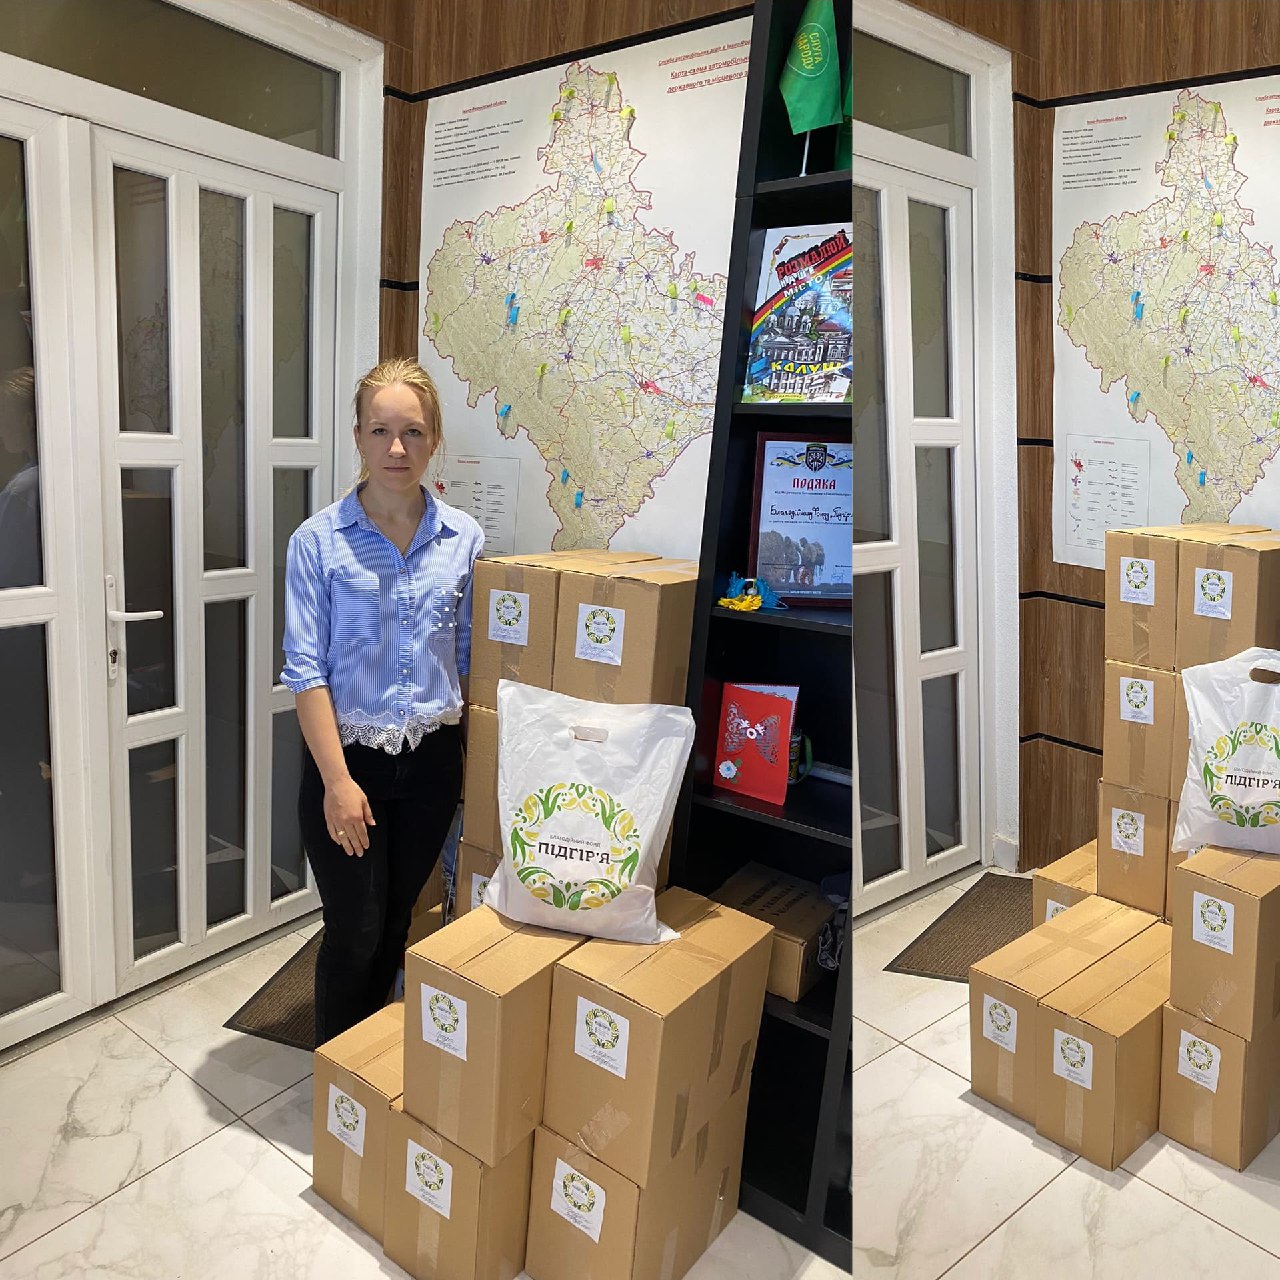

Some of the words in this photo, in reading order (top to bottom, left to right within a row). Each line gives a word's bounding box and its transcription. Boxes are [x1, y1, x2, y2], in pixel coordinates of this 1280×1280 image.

[776, 233, 847, 280] РОЗМАЛЮЙ
[771, 361, 843, 375] КАЛУШ
[792, 477, 836, 490] ПОДЯКА
[538, 841, 611, 865] ПІДГІР'Я
